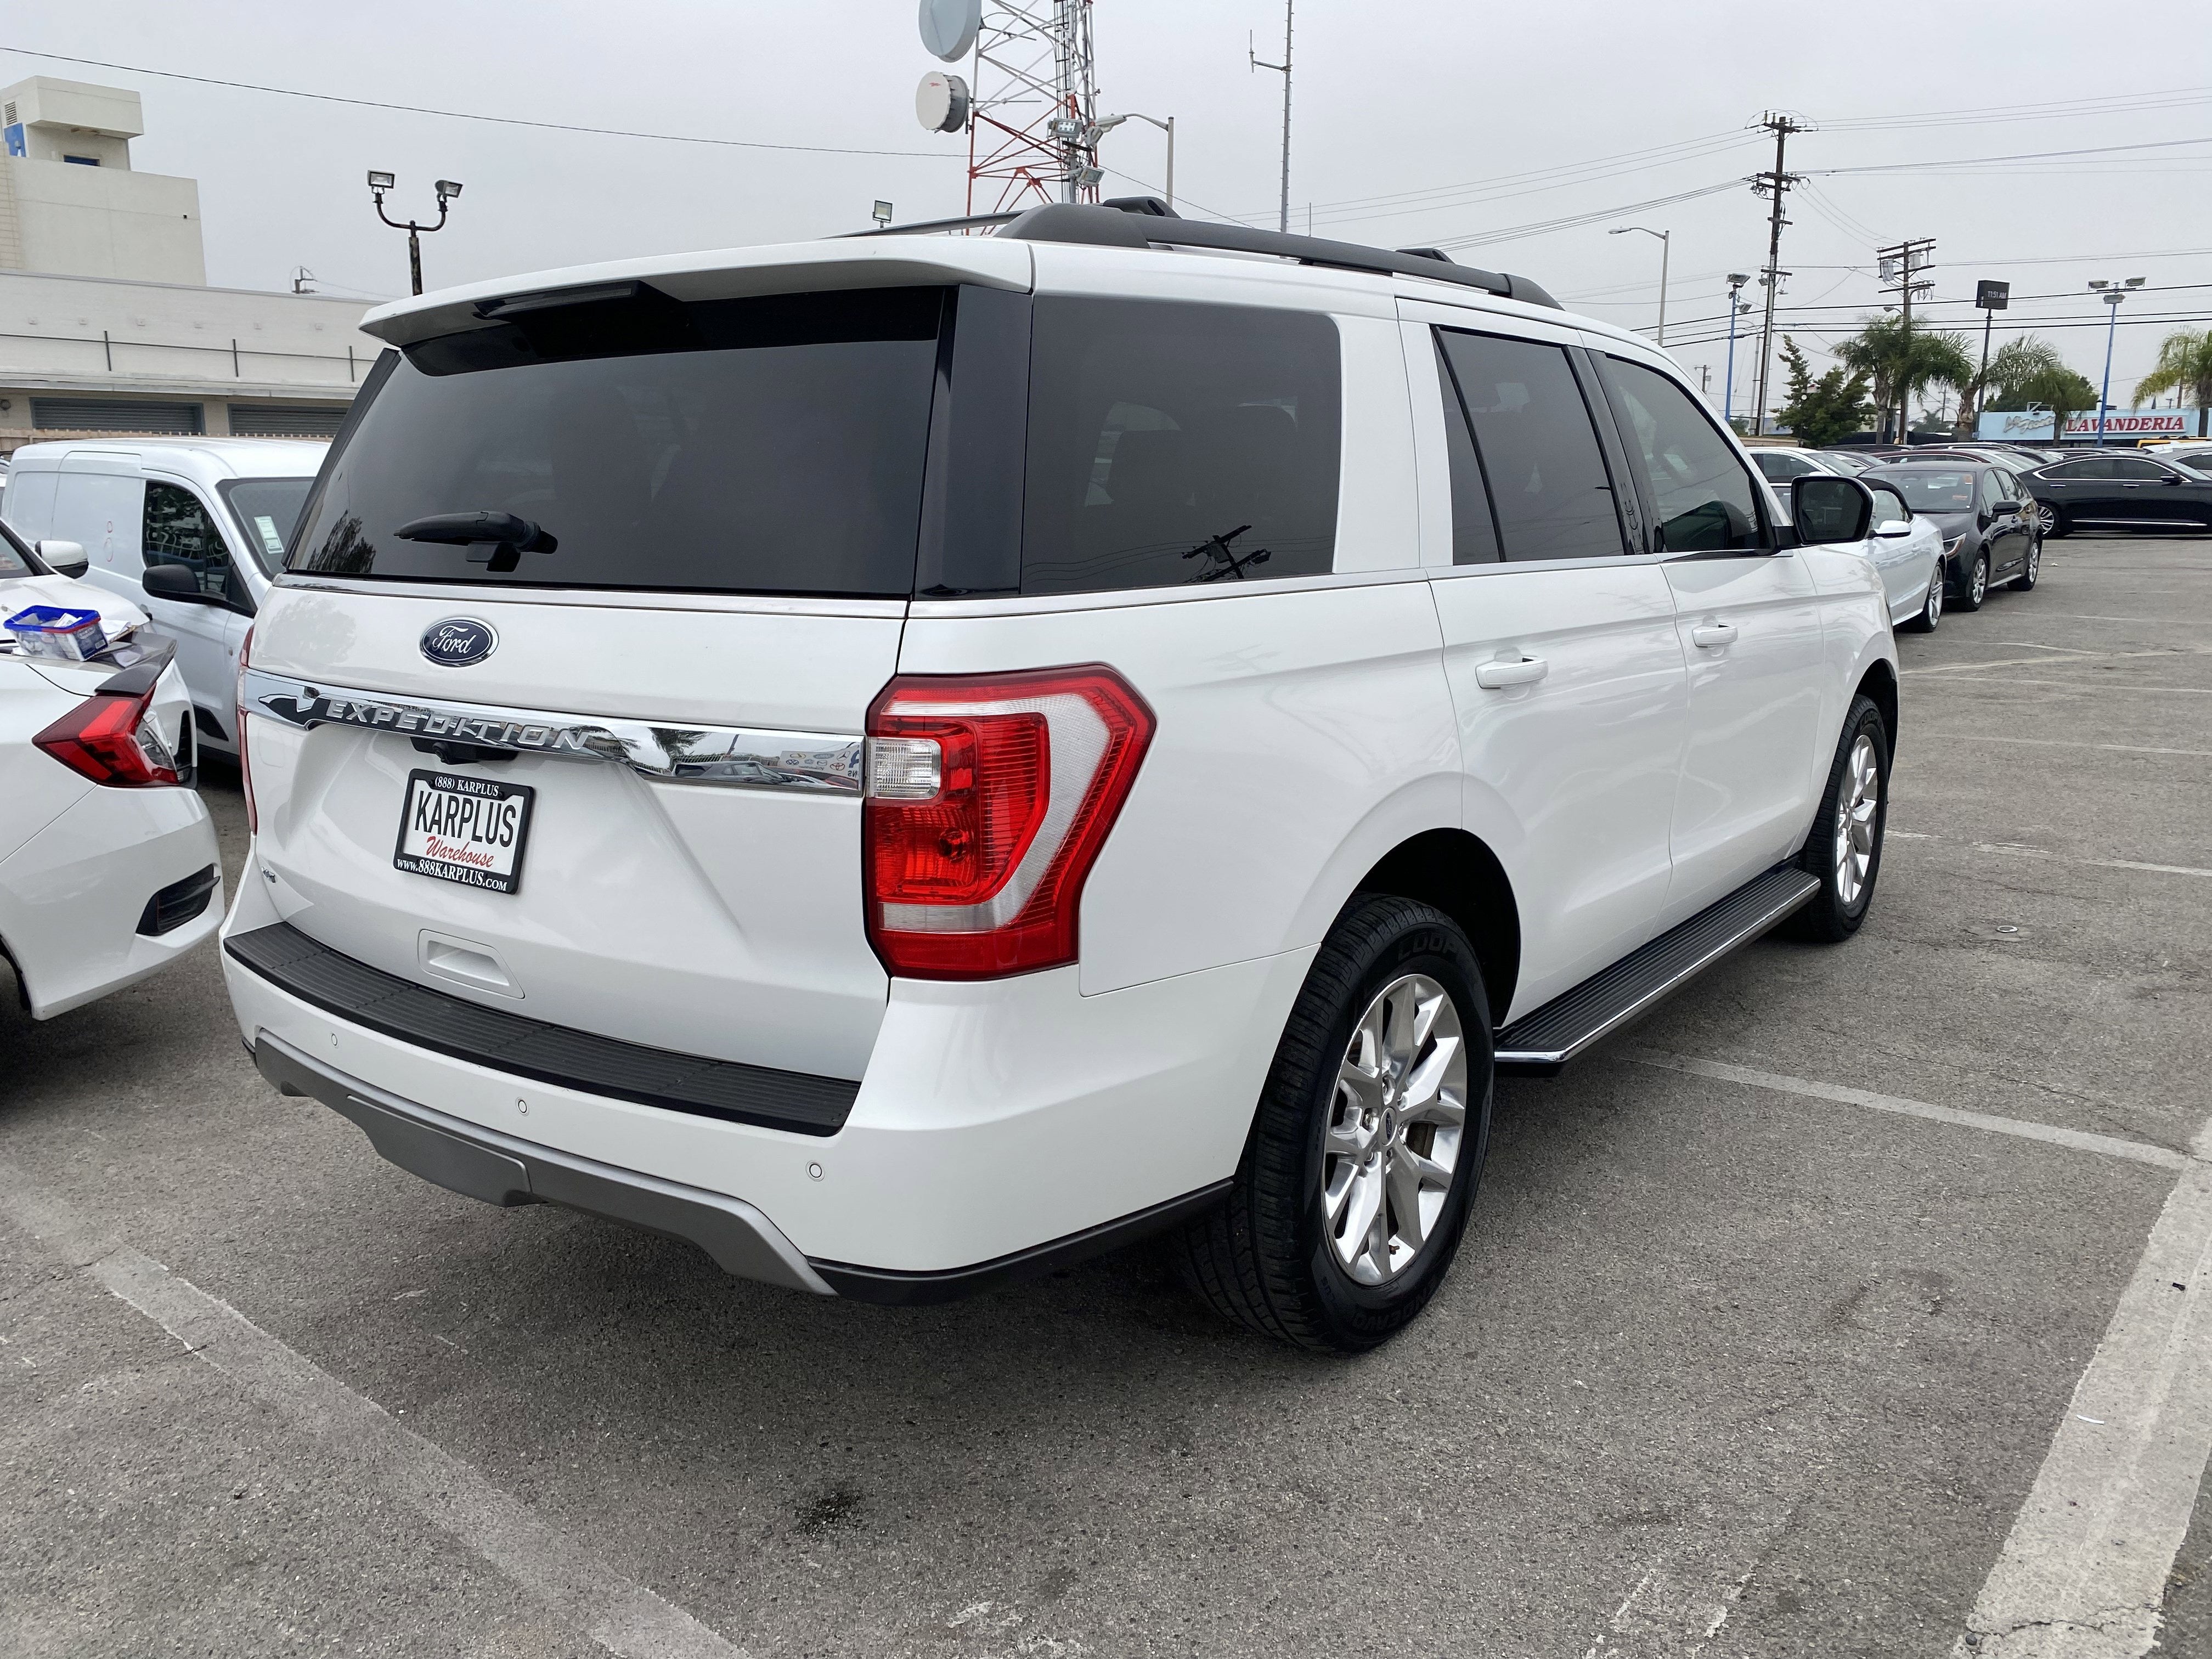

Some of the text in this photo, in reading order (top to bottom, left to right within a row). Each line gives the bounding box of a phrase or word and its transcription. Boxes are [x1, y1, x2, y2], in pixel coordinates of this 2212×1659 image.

[2066, 417, 2184, 432] LAVANDERIA
[432, 625, 477, 654] Ford
[325, 699, 590, 750] EXPEDITION
[435, 775, 499, 797] (888) KARPLUS
[414, 790, 517, 848] KARPLUS
[426, 836, 494, 868] Warehouse
[397, 859, 508, 891] www.888KARPLUS.COM
